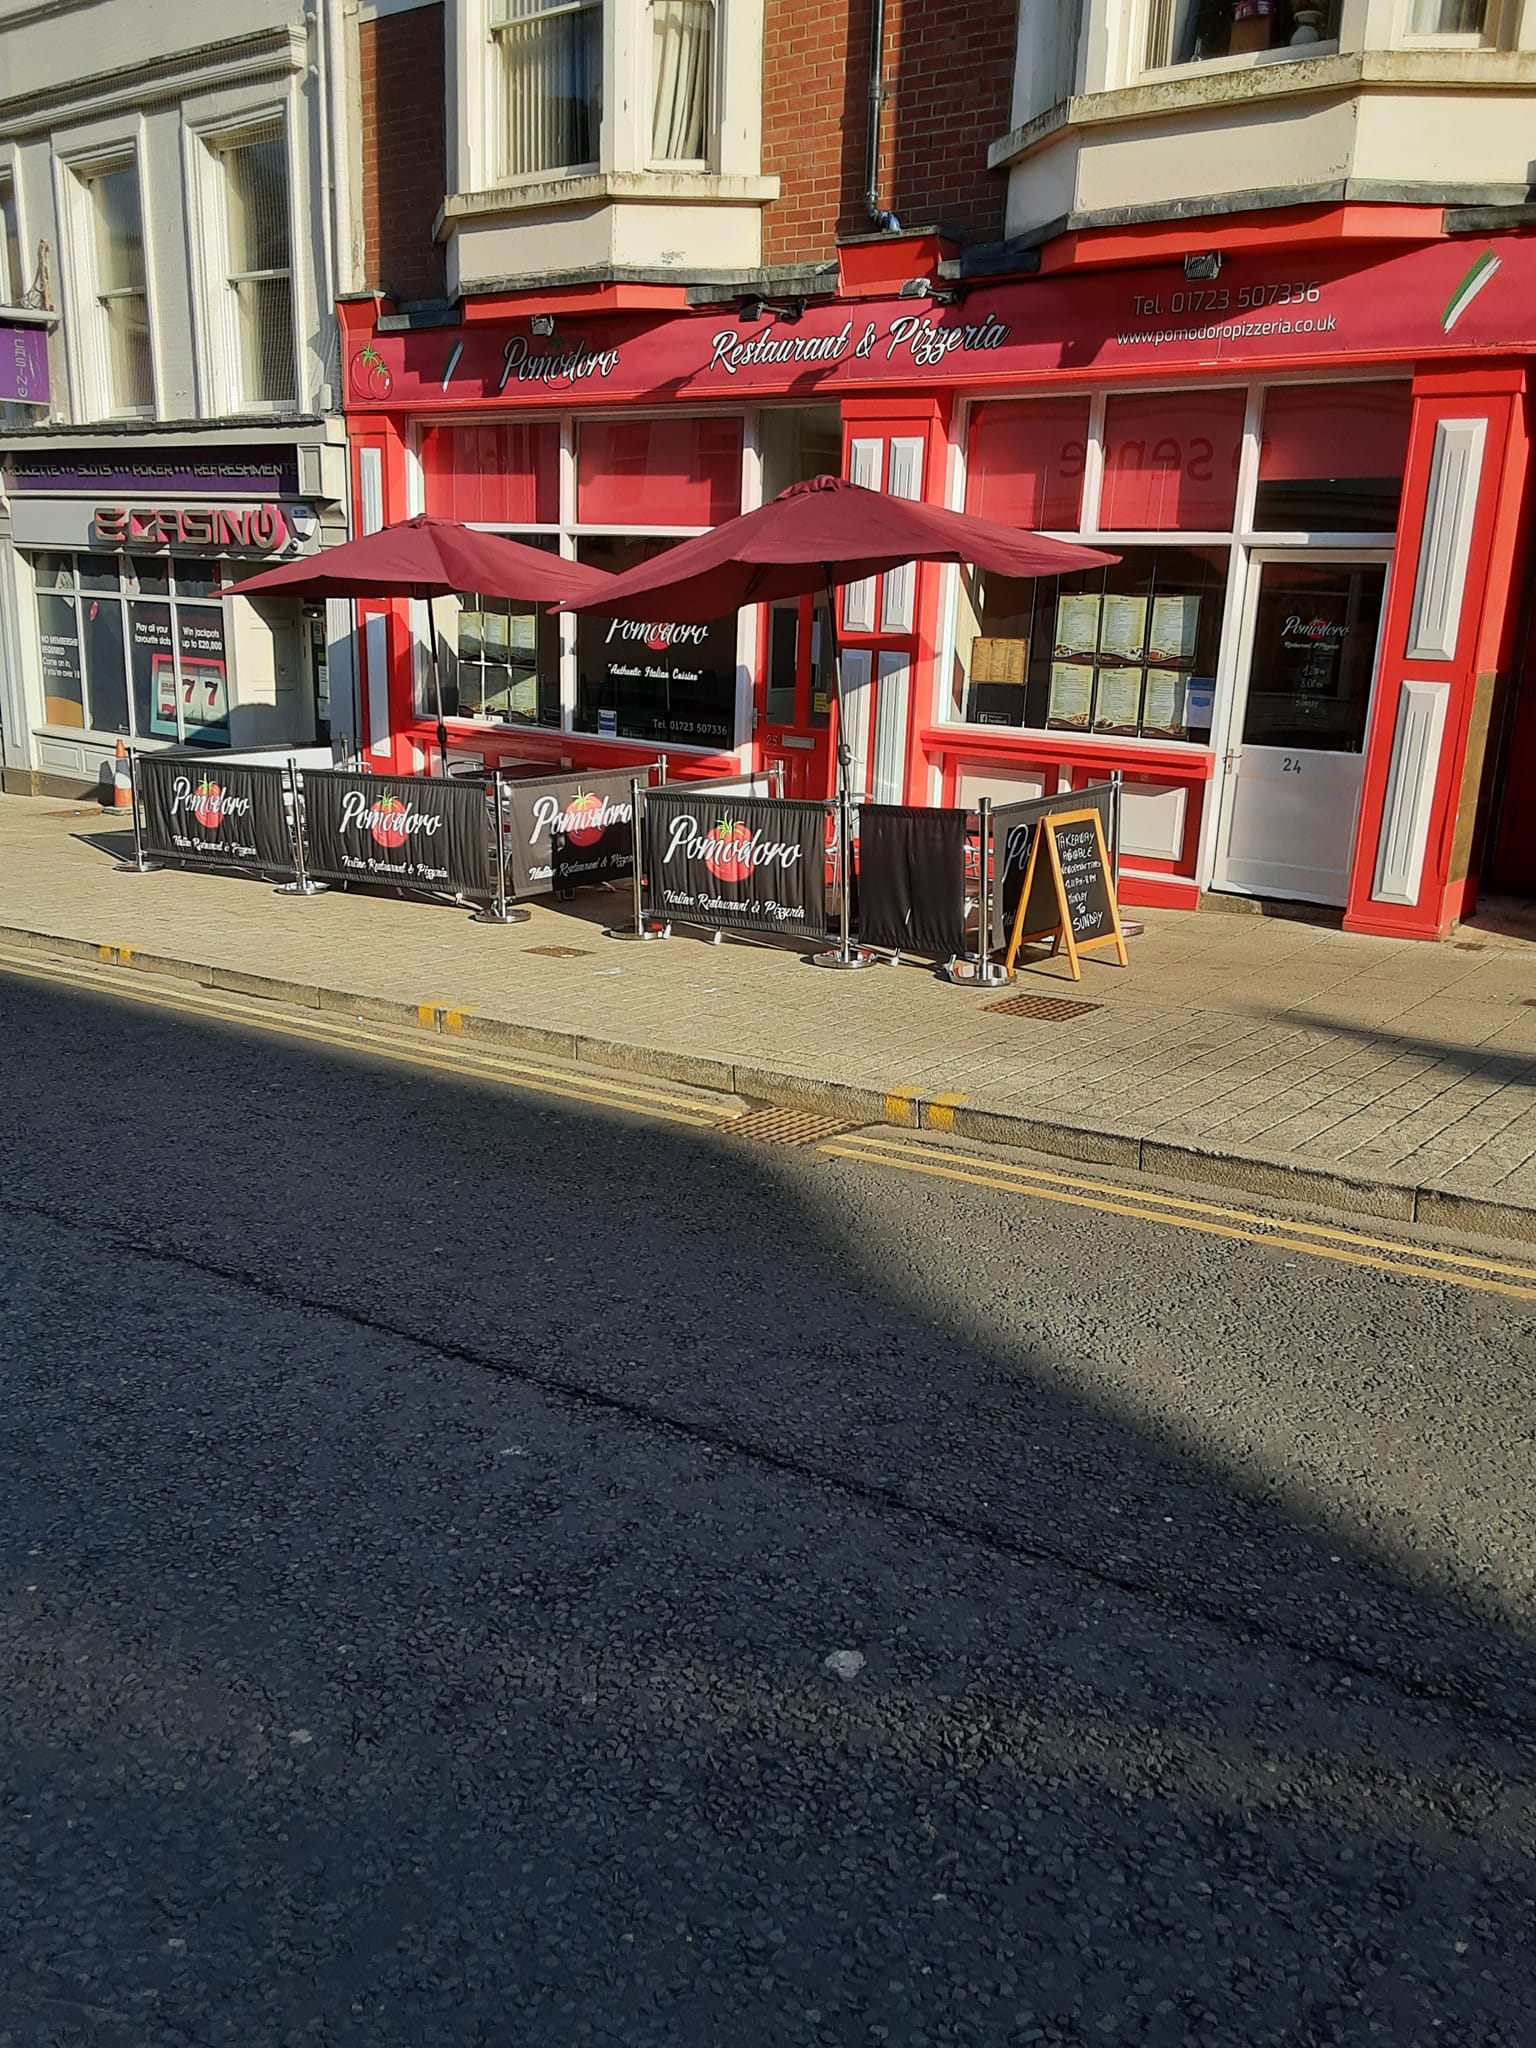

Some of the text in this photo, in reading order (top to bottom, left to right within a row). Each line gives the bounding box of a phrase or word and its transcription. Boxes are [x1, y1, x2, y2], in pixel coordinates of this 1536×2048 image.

[1133, 281, 1321, 316] Tel. 01723 507336
[1117, 314, 1337, 346] www.pomodoropizzeria.co.uk
[710, 313, 1010, 374] Restaurant & Pizzeria
[498, 336, 620, 390] Pomodoro
[77, 464, 112, 477] SLOTS
[132, 464, 174, 477] POKER
[193, 462, 298, 477] REFRESHMENTS
[135, 622, 147, 633] Play
[156, 625, 169, 634] your
[182, 626, 219, 638] Win jackpots
[605, 618, 709, 645] Pomodoro
[1281, 615, 1350, 637] Pomodoro
[182, 639, 190, 649] up
[198, 639, 222, 651] £20,000
[644, 664, 669, 679] Italian
[182, 679, 195, 703] 7
[205, 681, 218, 706] 7
[670, 720, 694, 733] 01723
[697, 723, 728, 736] 507336
[1282, 757, 1302, 774] 24
[171, 776, 250, 817] Pomodoro
[339, 790, 442, 837] Pomodoro
[529, 795, 632, 845] Pomodoro
[663, 814, 802, 868] Pomodoro
[408, 865, 415, 874] &
[600, 856, 608, 868] &
[610, 853, 633, 869] Pizzer
[698, 893, 749, 911] Restaurant
[751, 900, 761, 914] &
[764, 899, 806, 920] Pizzeria
[1072, 911, 1104, 931] SUNDAY
